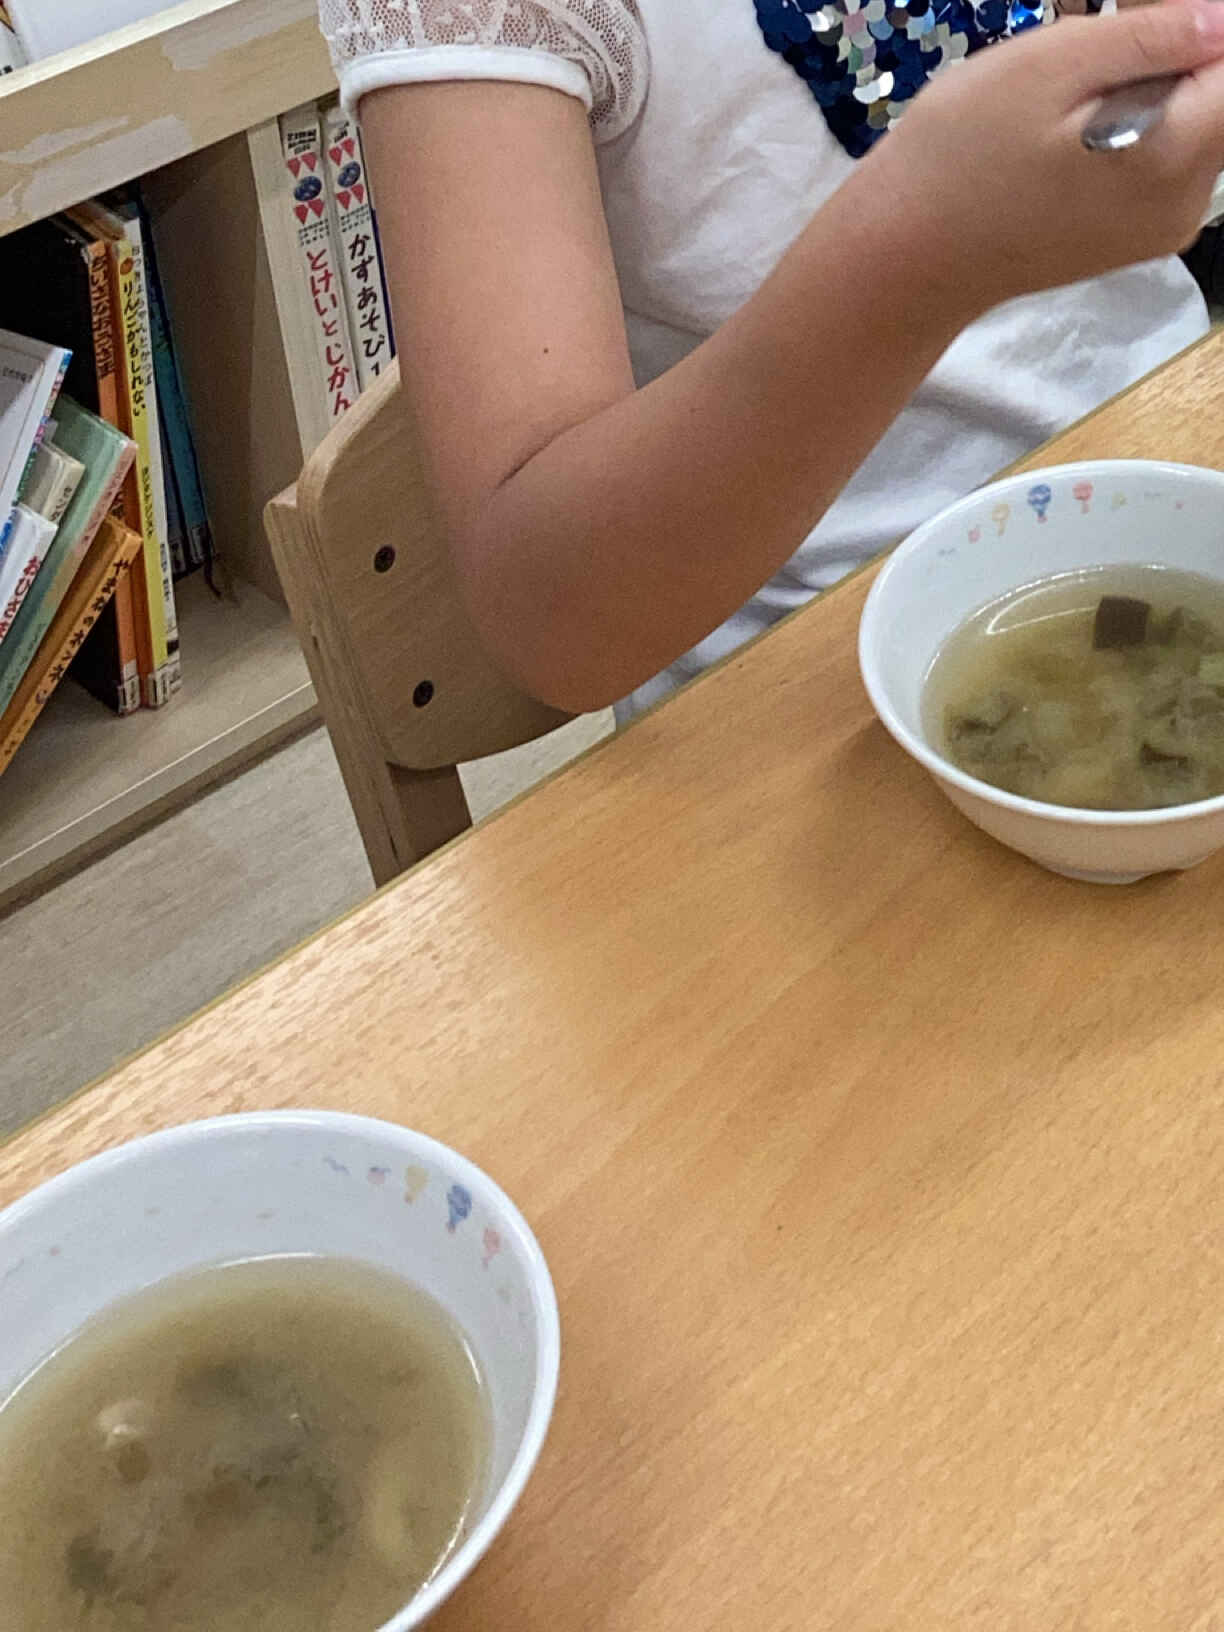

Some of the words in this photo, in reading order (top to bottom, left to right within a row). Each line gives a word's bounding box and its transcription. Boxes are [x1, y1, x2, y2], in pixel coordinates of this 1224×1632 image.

[123, 282, 146, 416] りんごかもしれない
[307, 247, 352, 416] とけいとじかん
[348, 233, 386, 357] かずあそび
